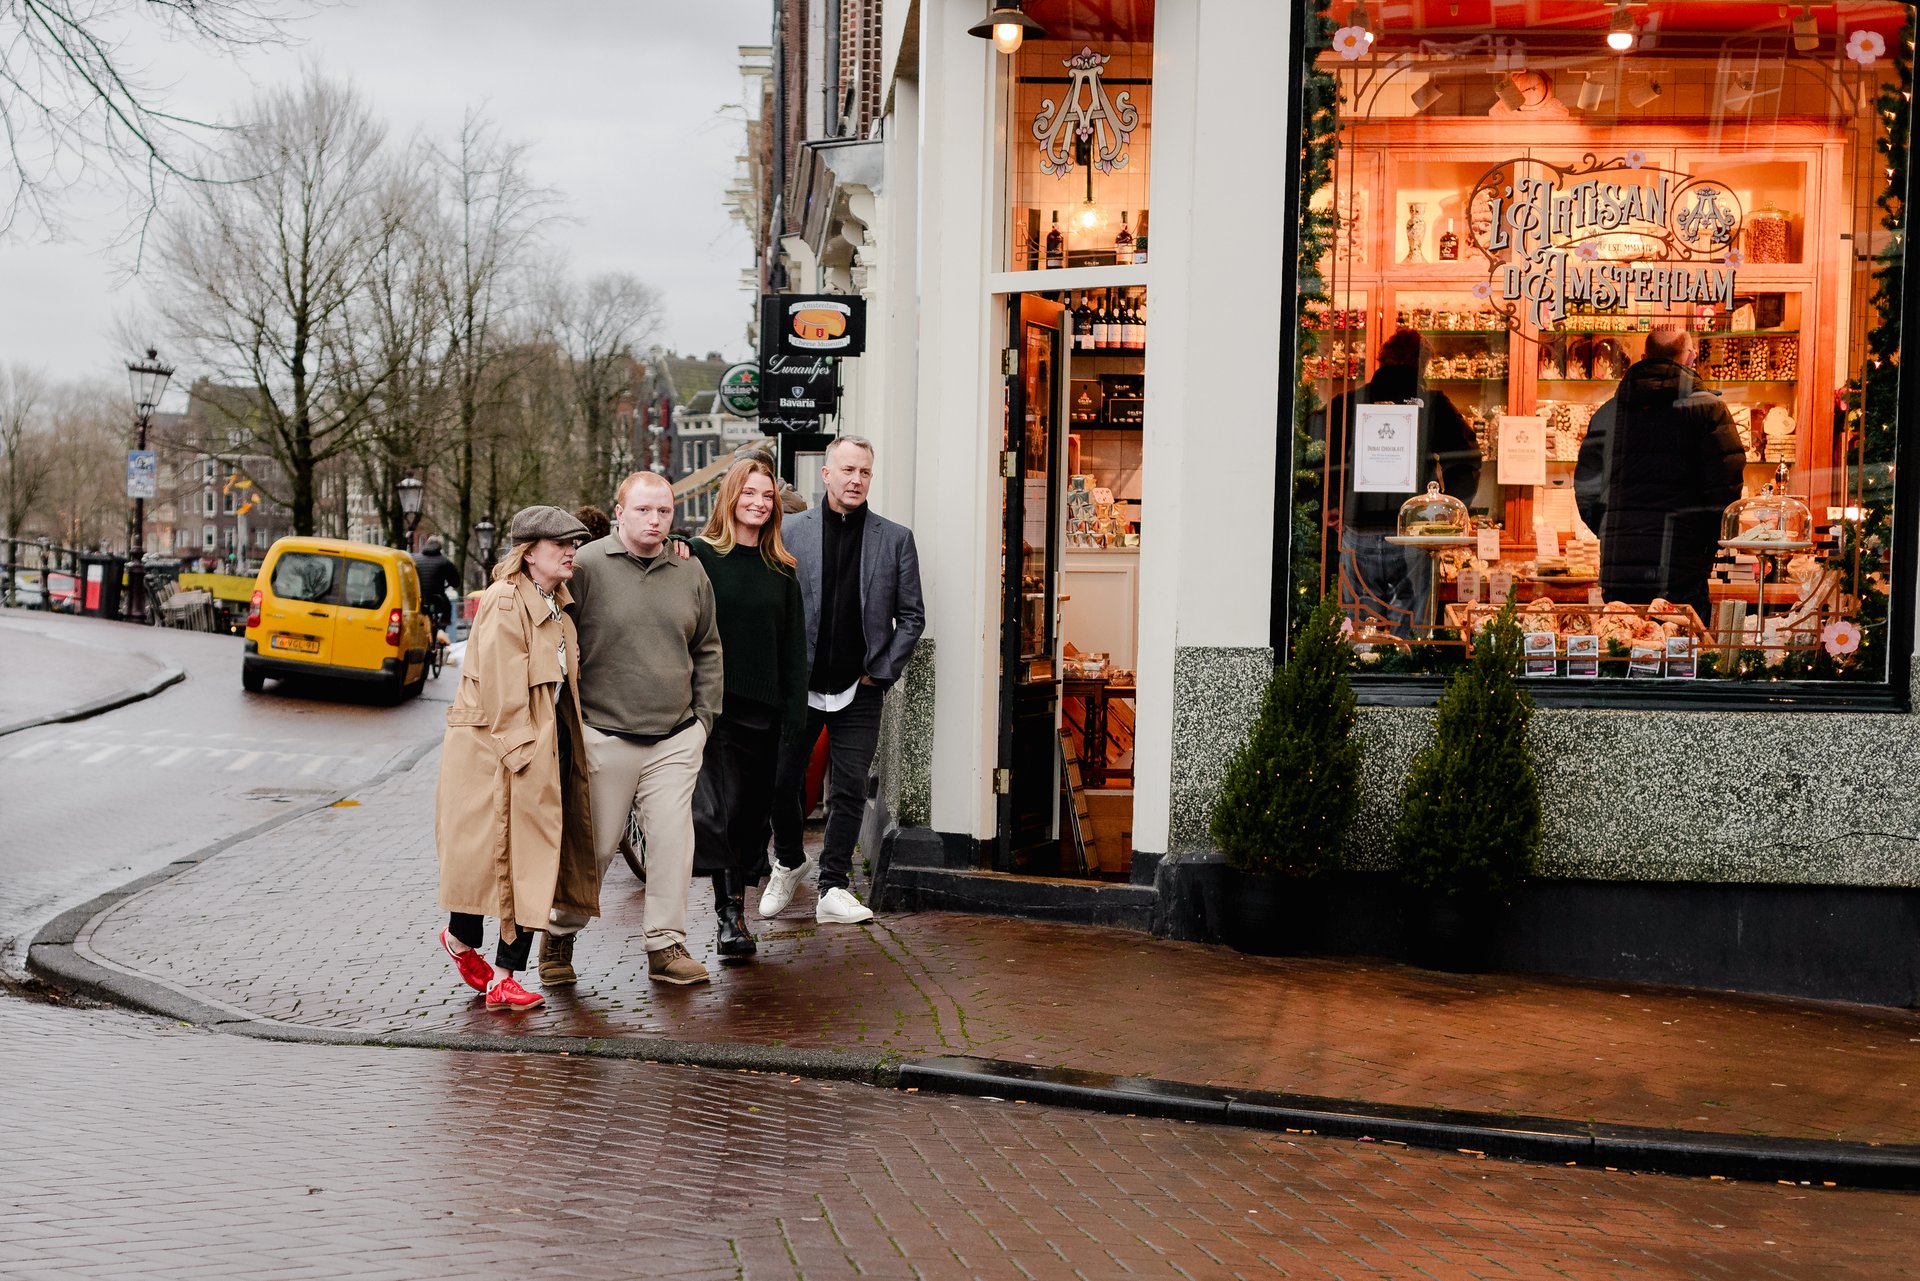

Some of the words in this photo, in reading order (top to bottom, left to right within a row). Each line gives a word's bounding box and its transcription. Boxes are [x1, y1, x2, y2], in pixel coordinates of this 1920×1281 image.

[1502, 249, 1737, 331] D'AMSTERDAM
[765, 354, 832, 384] Zwaantjes
[780, 398, 816, 408] Bavaria
